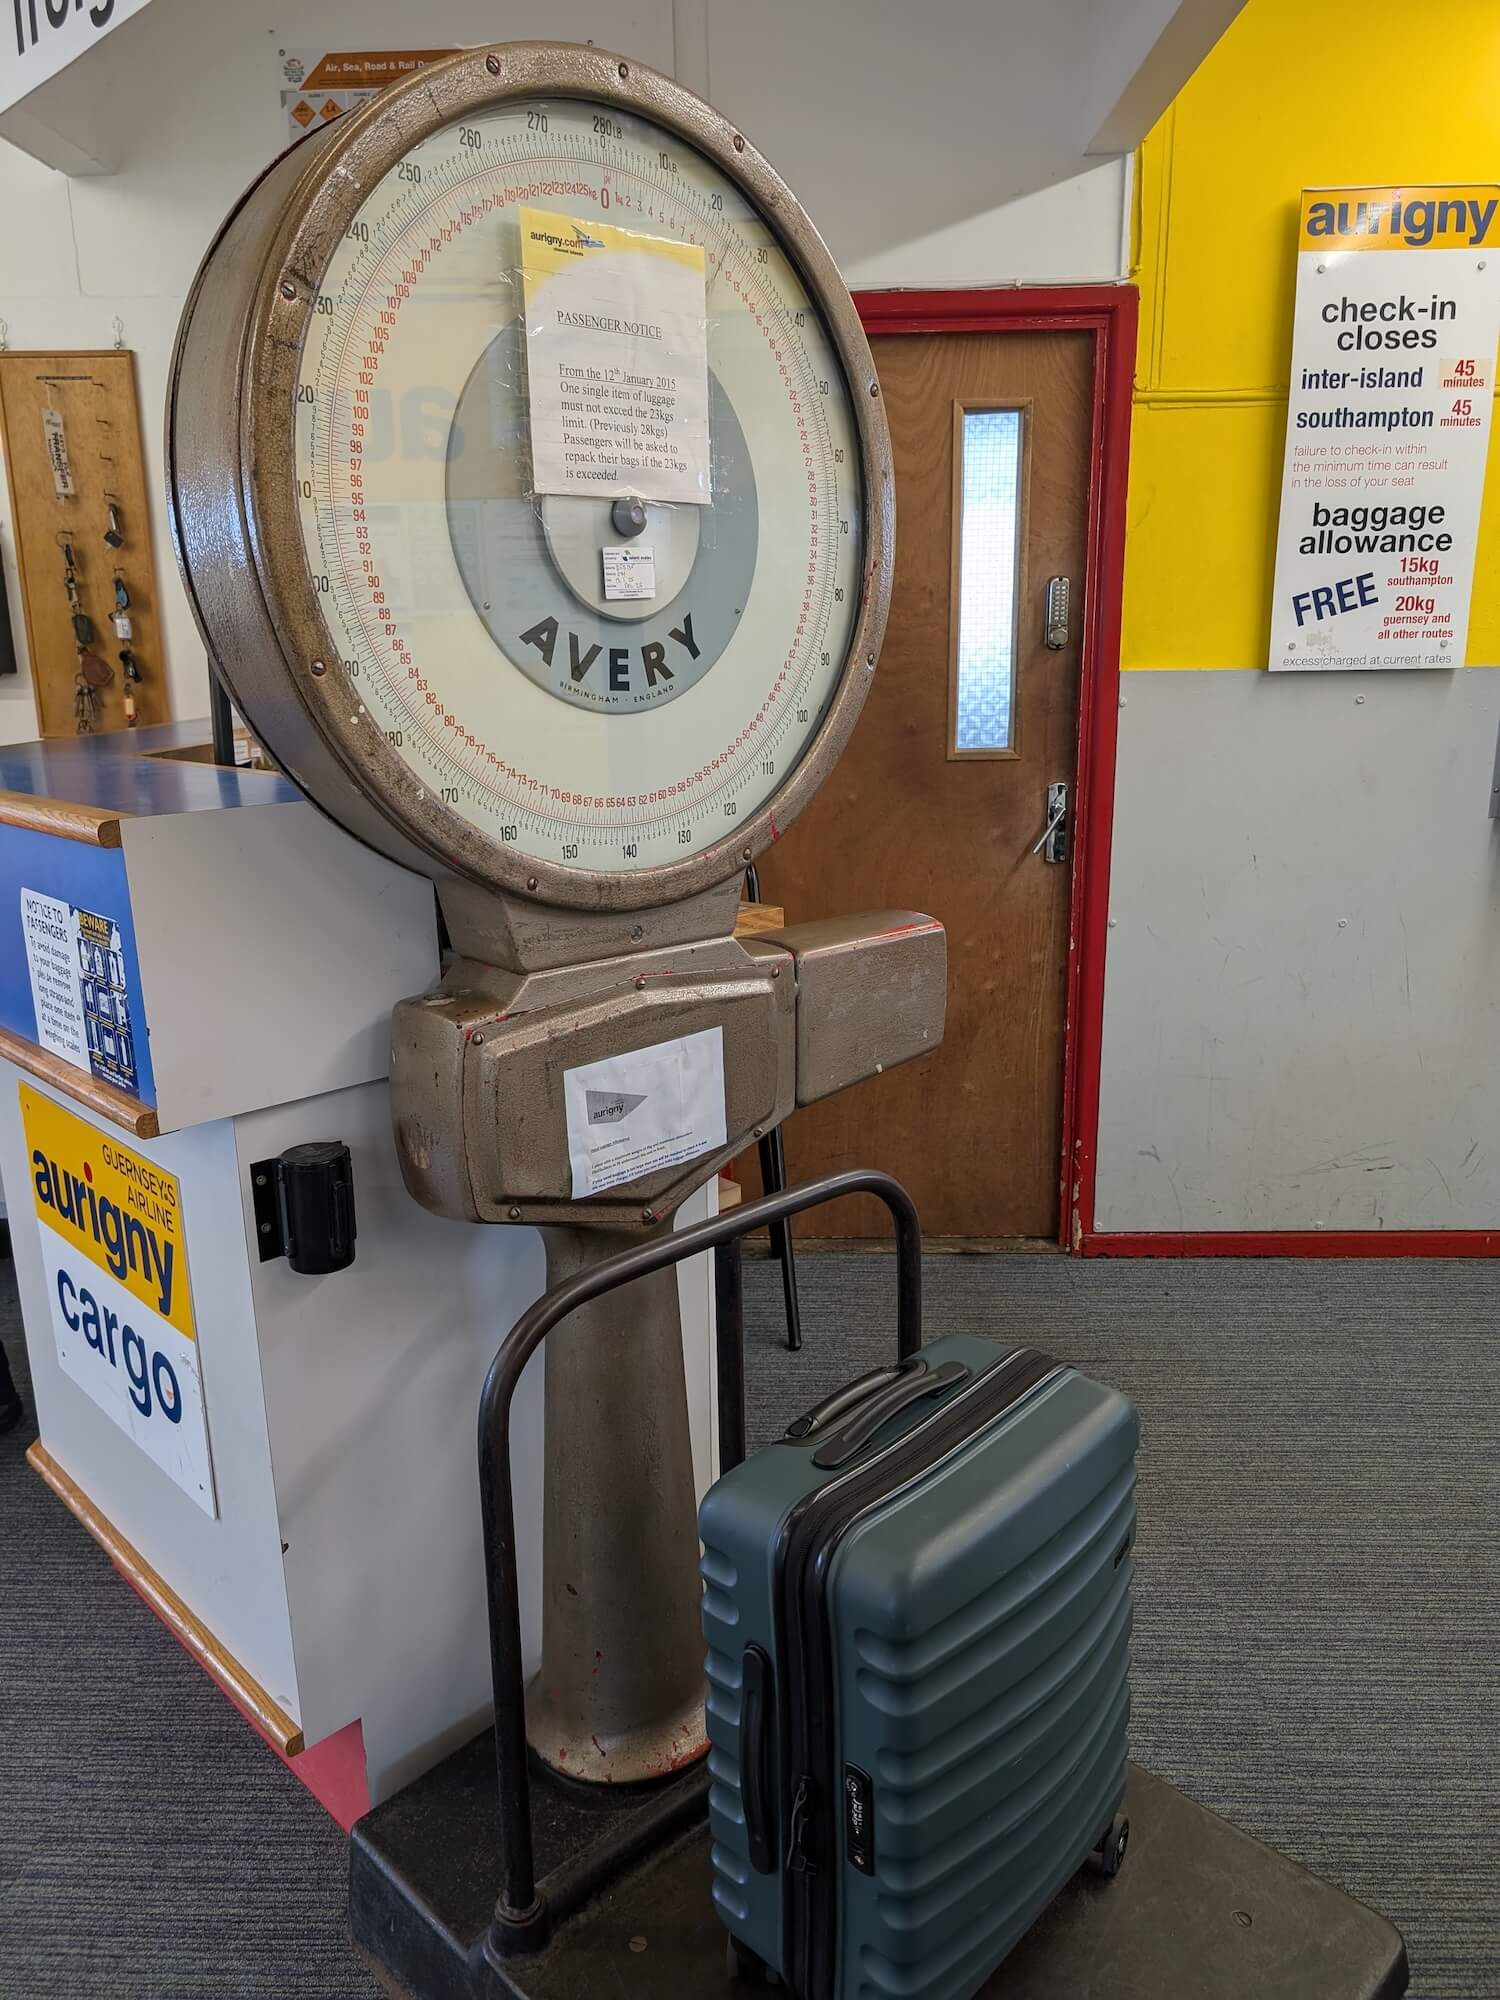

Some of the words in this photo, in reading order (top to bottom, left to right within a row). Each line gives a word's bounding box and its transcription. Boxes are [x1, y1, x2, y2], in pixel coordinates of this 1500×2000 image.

[325, 64, 341, 72] Air,
[343, 63, 362, 72] Sea,
[364, 62, 387, 70] Road
[398, 61, 415, 69] Rail
[527, 111, 548, 133] 270
[459, 127, 481, 149] 260
[398, 163, 421, 185] 250
[600, 188, 609, 209] 0
[711, 194, 723, 211] 20
[1306, 192, 1498, 246] aurigny
[530, 230, 584, 250] aurigny.com
[757, 249, 767, 264] 30
[411, 259, 424, 272] 110
[1321, 295, 1457, 323] check-in
[557, 310, 622, 333] PASSENGER
[624, 322, 662, 339] NOTICE
[795, 314, 805, 327] 40
[374, 327, 389, 340] 105
[1337, 325, 1438, 351] closes
[1455, 360, 1475, 376] 45
[559, 364, 584, 377] From
[586, 368, 601, 380] the
[604, 367, 621, 382] 12th
[623, 370, 654, 389] January
[656, 375, 676, 389] 2015
[1301, 366, 1423, 390] inter-island
[1443, 376, 1485, 388] minutes
[560, 381, 580, 394] One
[582, 383, 609, 400] single
[611, 385, 630, 399] item
[632, 387, 643, 401] of
[644, 388, 676, 407] luggage
[819, 382, 829, 395] 50
[353, 406, 369, 419] 100
[561, 400, 583, 413] must
[585, 402, 601, 414] not
[603, 404, 633, 418] exceed
[635, 407, 648, 419] the
[649, 409, 674, 423] 23kgs
[1452, 399, 1472, 416] 45
[1296, 407, 1433, 431] southampton
[1440, 415, 1481, 427] minutes
[561, 416, 588, 430] limit.
[589, 418, 639, 436] (Previously
[640, 421, 669, 439] 28kgs)
[563, 432, 613, 450] Passengers
[614, 436, 631, 449] will
[632, 437, 643, 450] be
[645, 439, 669, 453] asked
[670, 441, 678, 454] to
[1294, 444, 1327, 457] failure
[1330, 445, 1342, 456] to
[1344, 444, 1392, 455] check-in
[1395, 443, 1427, 455] within
[565, 452, 596, 467] repack
[598, 452, 619, 465] their
[620, 454, 640, 470] bags
[641, 455, 649, 467] if
[650, 456, 663, 469] the
[664, 458, 688, 472] 23kgs
[835, 450, 844, 463] 60
[1293, 461, 1310, 472] the
[1313, 460, 1364, 472] minimum
[1367, 460, 1391, 471] time
[1394, 461, 1414, 471] can
[1418, 458, 1448, 470] result
[565, 469, 574, 479] is
[576, 469, 619, 481] exceeded.
[1291, 477, 1301, 488] in
[1304, 476, 1321, 488] the
[1324, 476, 1347, 487] loss
[1350, 476, 1361, 487] of
[1364, 477, 1389, 488] your
[1392, 475, 1415, 486] seat
[351, 492, 364, 505] 95
[1312, 502, 1445, 532] baggage
[840, 521, 848, 534] 70
[1299, 530, 1453, 555] allowance
[1400, 557, 1440, 575] 15kg
[367, 576, 380, 588] 90
[1387, 575, 1453, 588] southampton
[835, 589, 843, 601] 80
[1292, 572, 1379, 627] FREE
[1395, 596, 1435, 614] 20kg
[1384, 615, 1429, 627] guernsey
[1432, 613, 1451, 624] and
[1377, 629, 1390, 640] all
[1393, 629, 1419, 639] other
[1421, 628, 1453, 639] routes
[400, 653, 411, 664] 85
[519, 612, 701, 691] AVERY
[821, 653, 829, 666] 90
[1282, 656, 1321, 667] excess
[1321, 655, 1367, 667] charged
[1369, 655, 1381, 665] at
[1383, 655, 1422, 665] current
[1425, 654, 1452, 664] rates
[560, 680, 619, 704] BIRMINGHAM
[634, 684, 674, 703] ENGLAND
[444, 715, 455, 727] 80
[797, 710, 808, 722] 100
[496, 762, 506, 772] 75
[761, 762, 774, 775] 110
[440, 788, 459, 803] 170
[550, 788, 560, 800] 70
[658, 789, 667, 800] 60
[606, 797, 615, 808] 65
[723, 803, 736, 816] 120
[500, 825, 517, 841] 160
[678, 830, 691, 844] 130
[562, 844, 578, 859] 150
[622, 844, 637, 858] 140
[26, 898, 52, 920] NOTICE
[53, 908, 63, 924] TO
[79, 911, 109, 935] BEWARE
[37, 941, 51, 954] avoid
[51, 945, 71, 965] damage
[593, 1103, 624, 1120] aurigny
[101, 1143, 176, 1207] GUERNSEY'S
[127, 1186, 175, 1234] AIRLINE
[32, 1149, 174, 1316] aurigny
[57, 1269, 183, 1425] cargo
